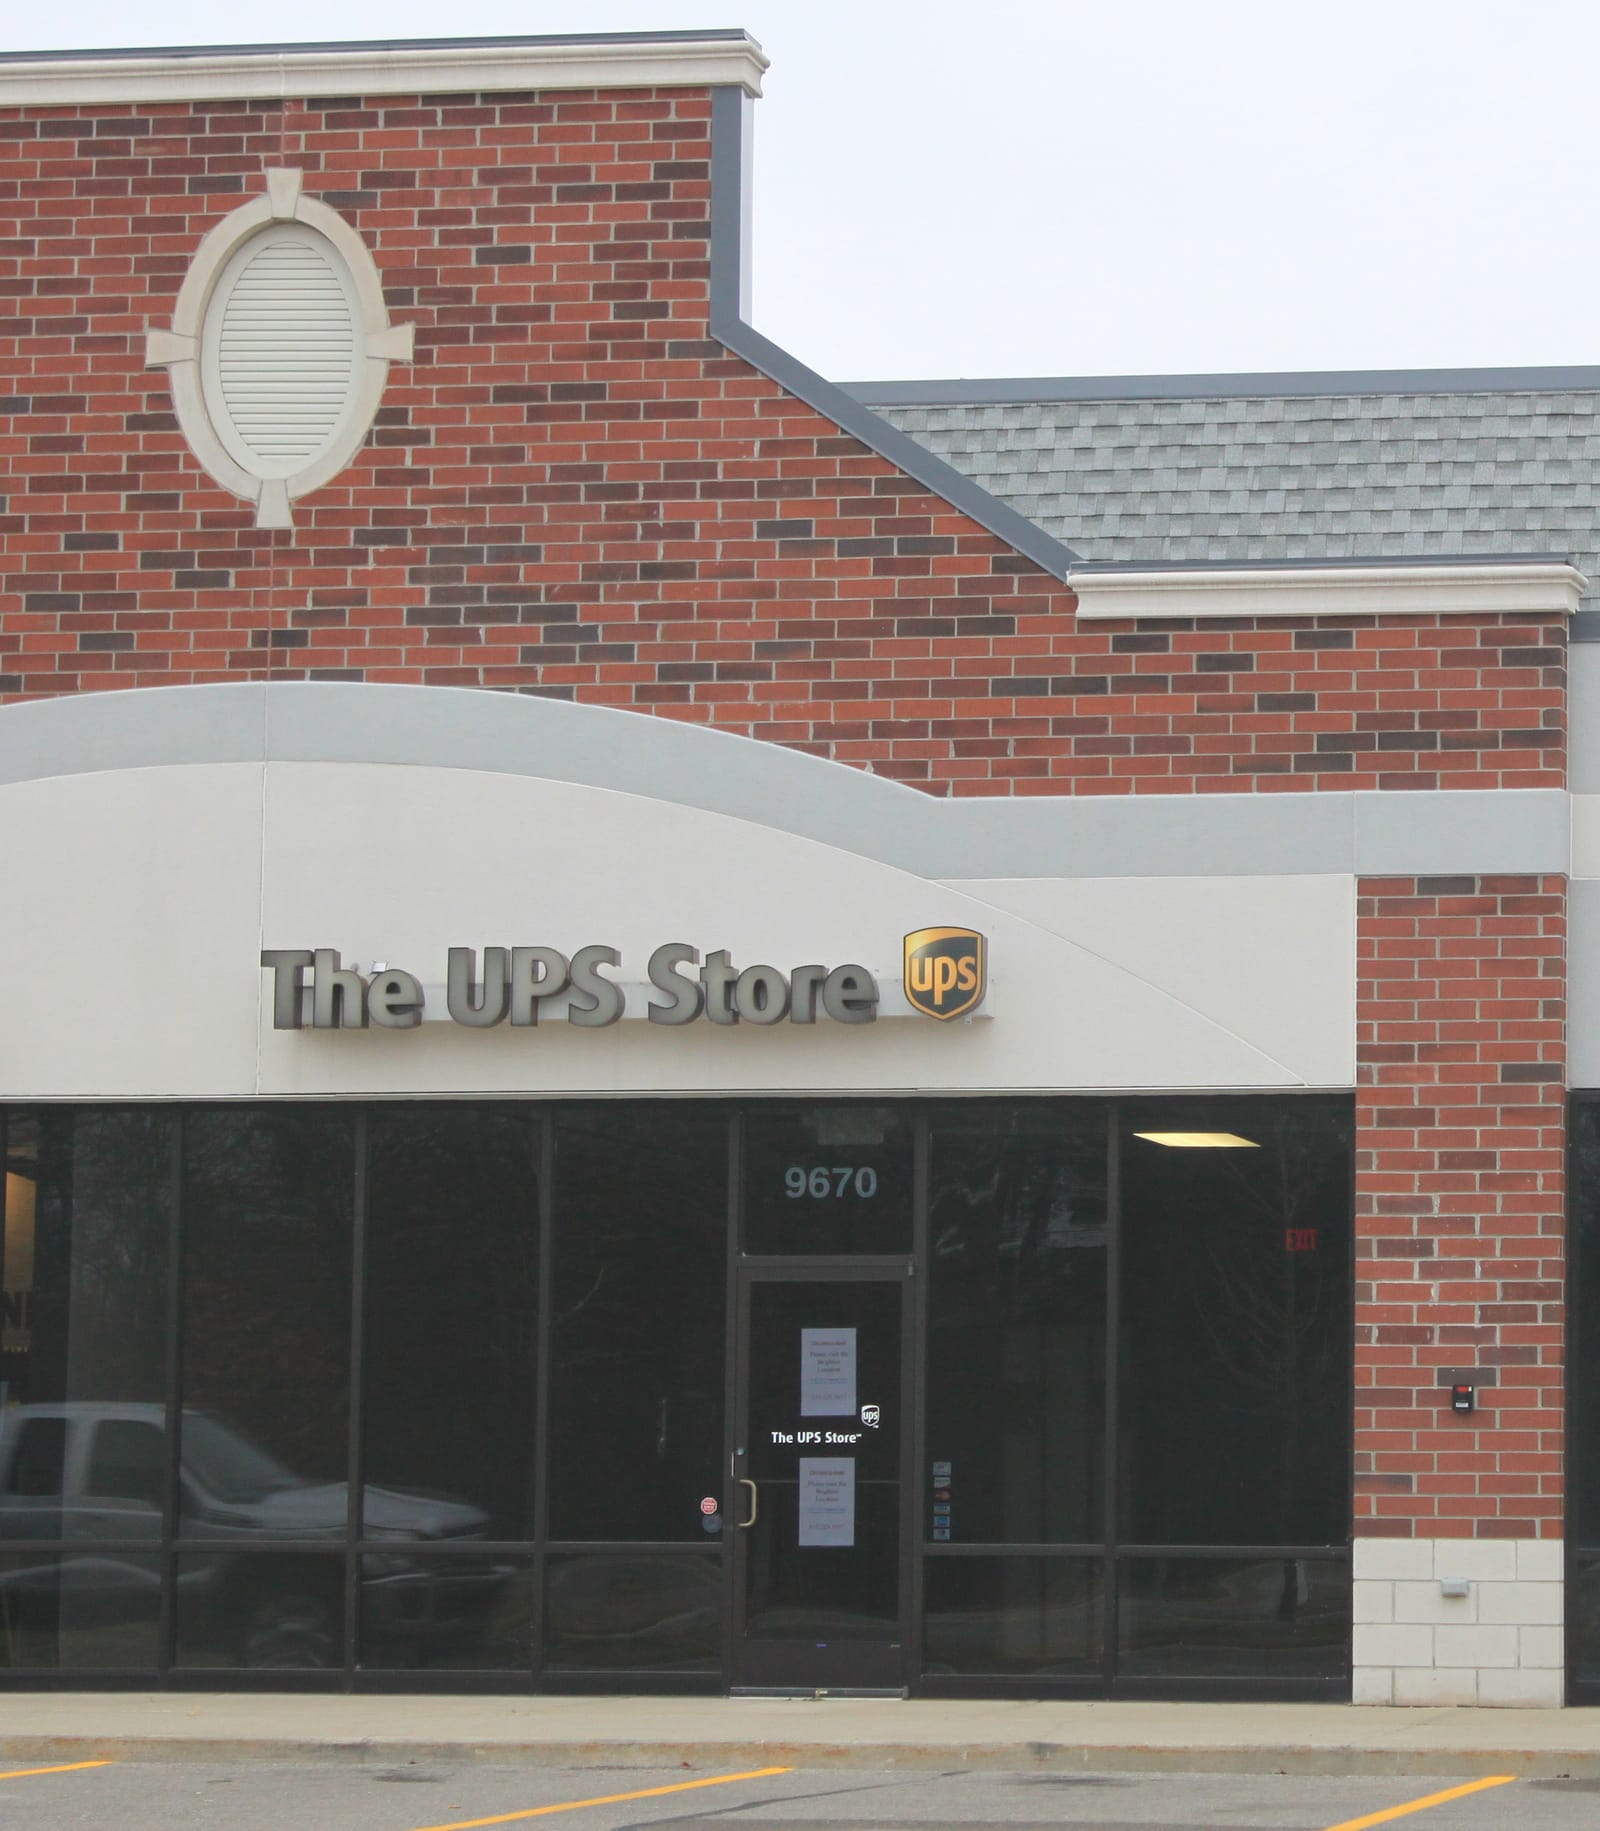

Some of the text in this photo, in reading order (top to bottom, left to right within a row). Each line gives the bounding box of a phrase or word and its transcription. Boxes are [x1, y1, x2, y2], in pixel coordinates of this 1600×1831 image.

[260, 942, 880, 1030] The UPS Store
[911, 955, 978, 1006] ups
[784, 1166, 878, 1199] 9670
[862, 1411, 878, 1423] ups
[771, 1431, 794, 1443] The
[797, 1431, 822, 1443] UPS
